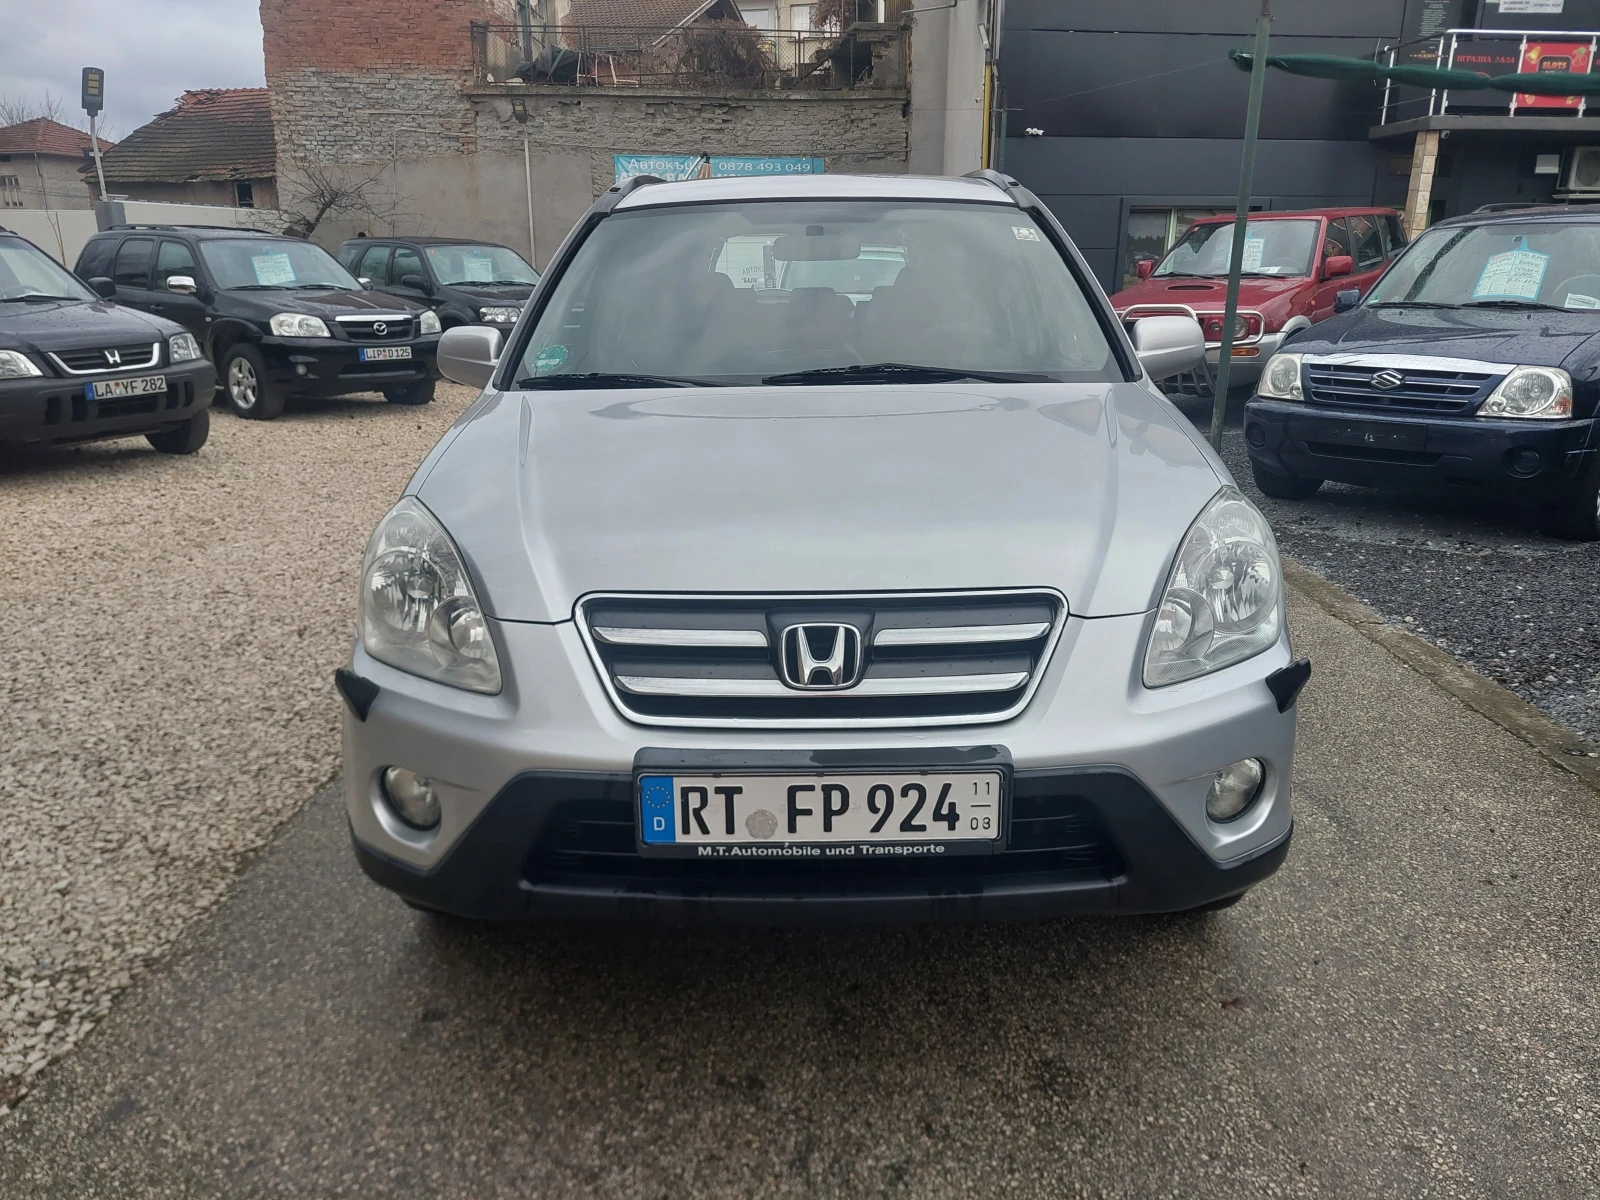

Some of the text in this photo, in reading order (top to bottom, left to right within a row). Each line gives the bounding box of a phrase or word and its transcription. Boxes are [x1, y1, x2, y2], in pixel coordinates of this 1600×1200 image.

[1542, 61, 1567, 69] SLOTS
[718, 162, 811, 172] 0878 493 049
[365, 348, 411, 359] LIP D 125
[94, 377, 165, 397] LA YF 282
[972, 781, 990, 796] 11
[680, 782, 960, 835] RT FP 924
[653, 816, 666, 831] D
[825, 845, 855, 855] und
[859, 844, 945, 855] Transporte
